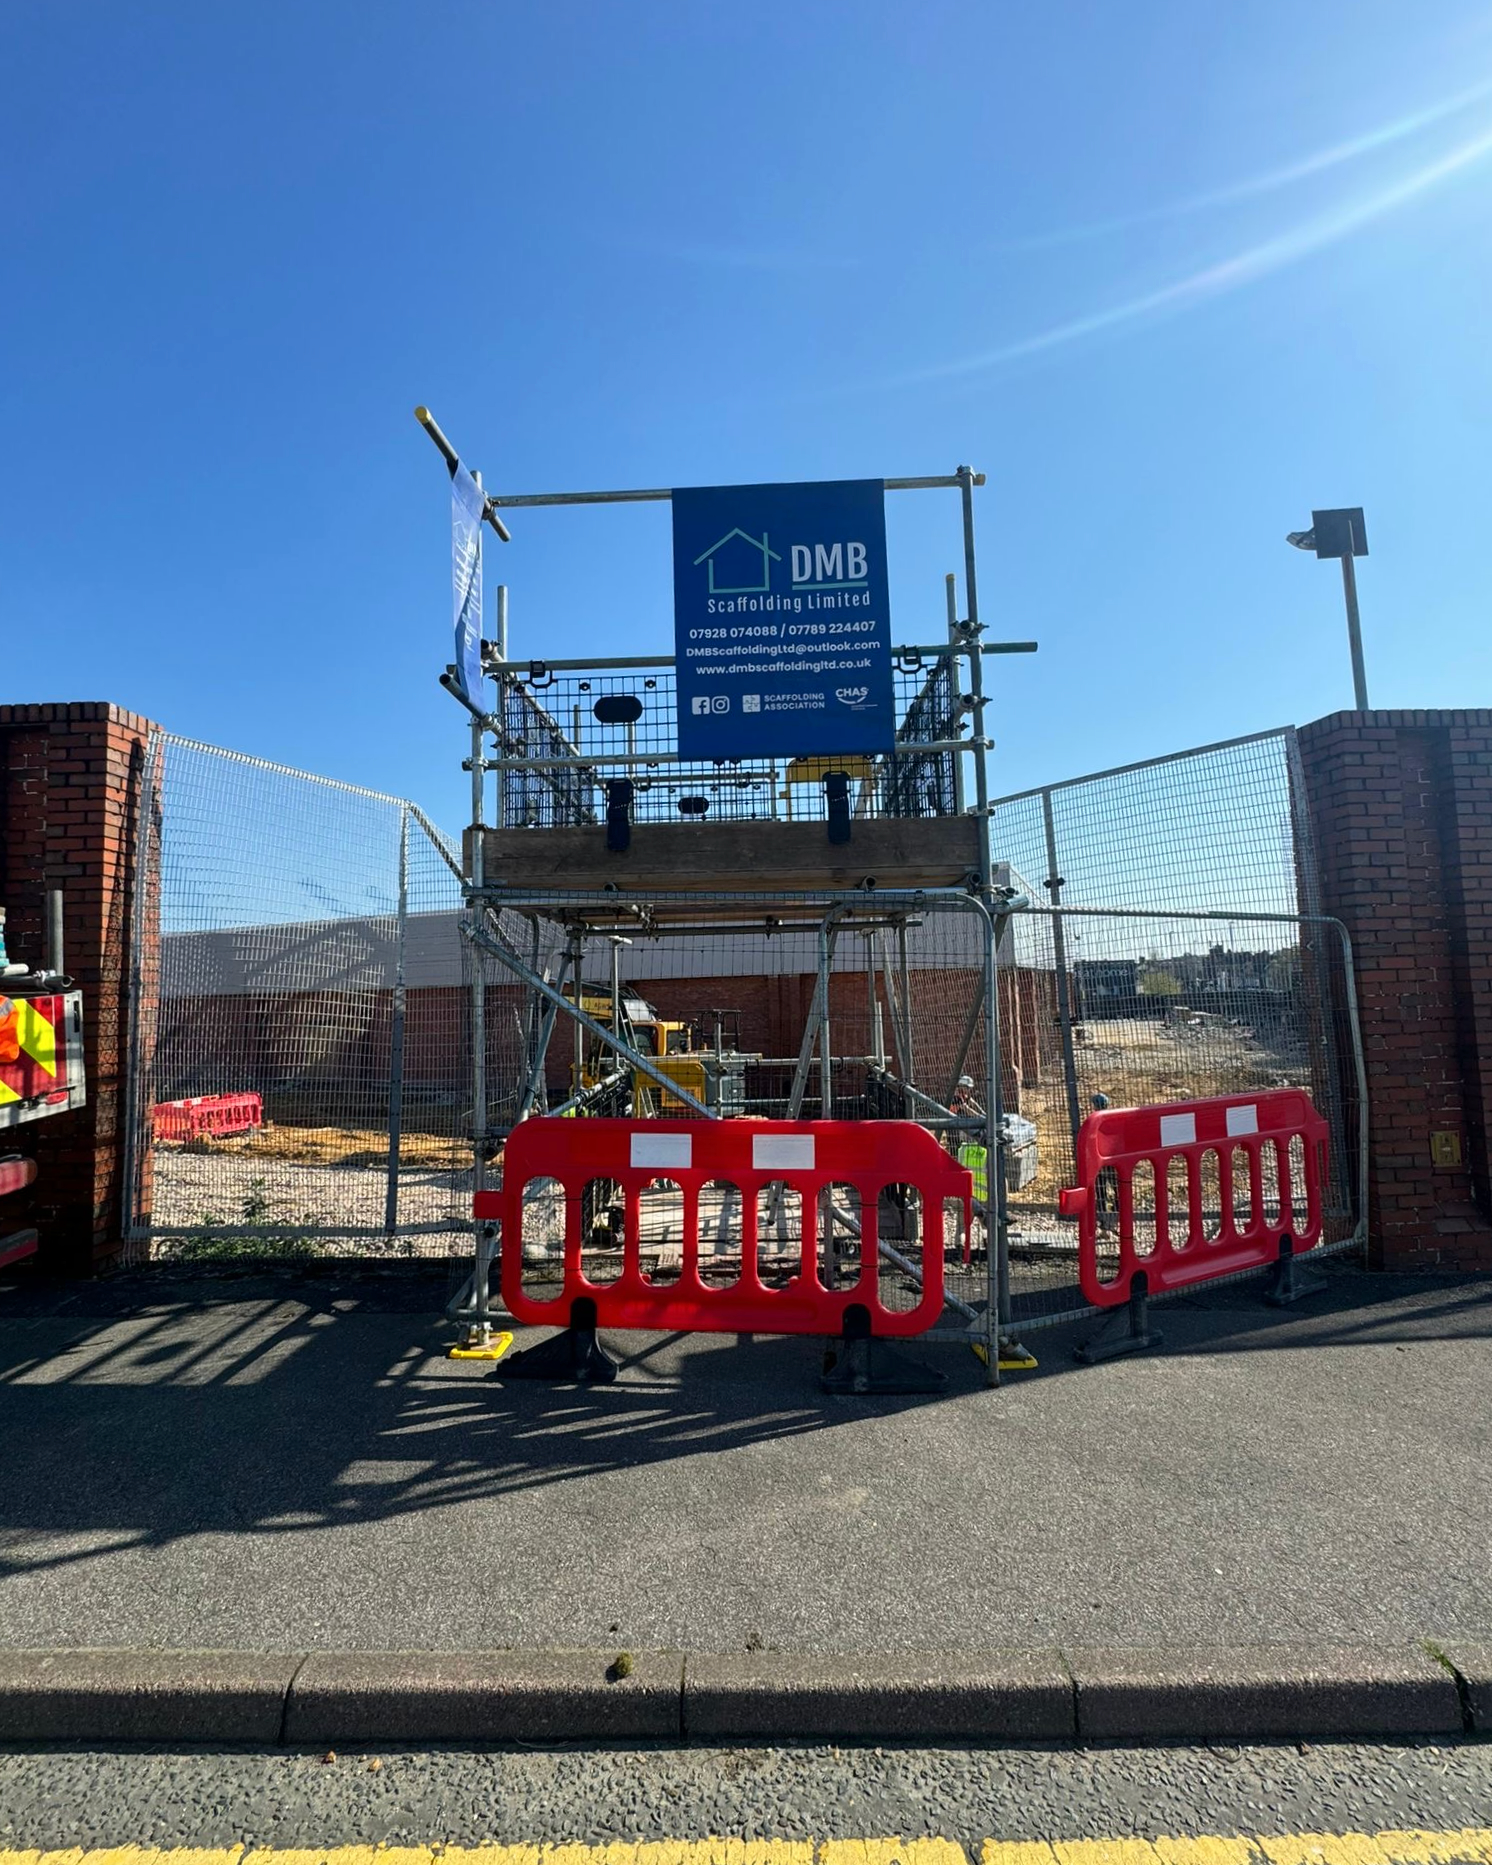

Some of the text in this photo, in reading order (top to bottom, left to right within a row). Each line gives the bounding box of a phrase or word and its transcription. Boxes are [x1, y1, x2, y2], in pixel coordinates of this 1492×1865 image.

[791, 542, 868, 582] DMB
[708, 590, 870, 613] Scaffolding Limited
[689, 628, 727, 639] 07928
[730, 625, 778, 638] 074088
[788, 623, 826, 635] 07789
[828, 621, 876, 633] 224407
[686, 640, 881, 657] DMBScaffoldingLtd@outlook.com
[696, 658, 872, 674] www.dmbscaffoldingltd.co.uk
[764, 693, 825, 702] SCAFFOLDING
[835, 687, 869, 698] CHAS
[764, 702, 825, 711] ASSOCIATION
